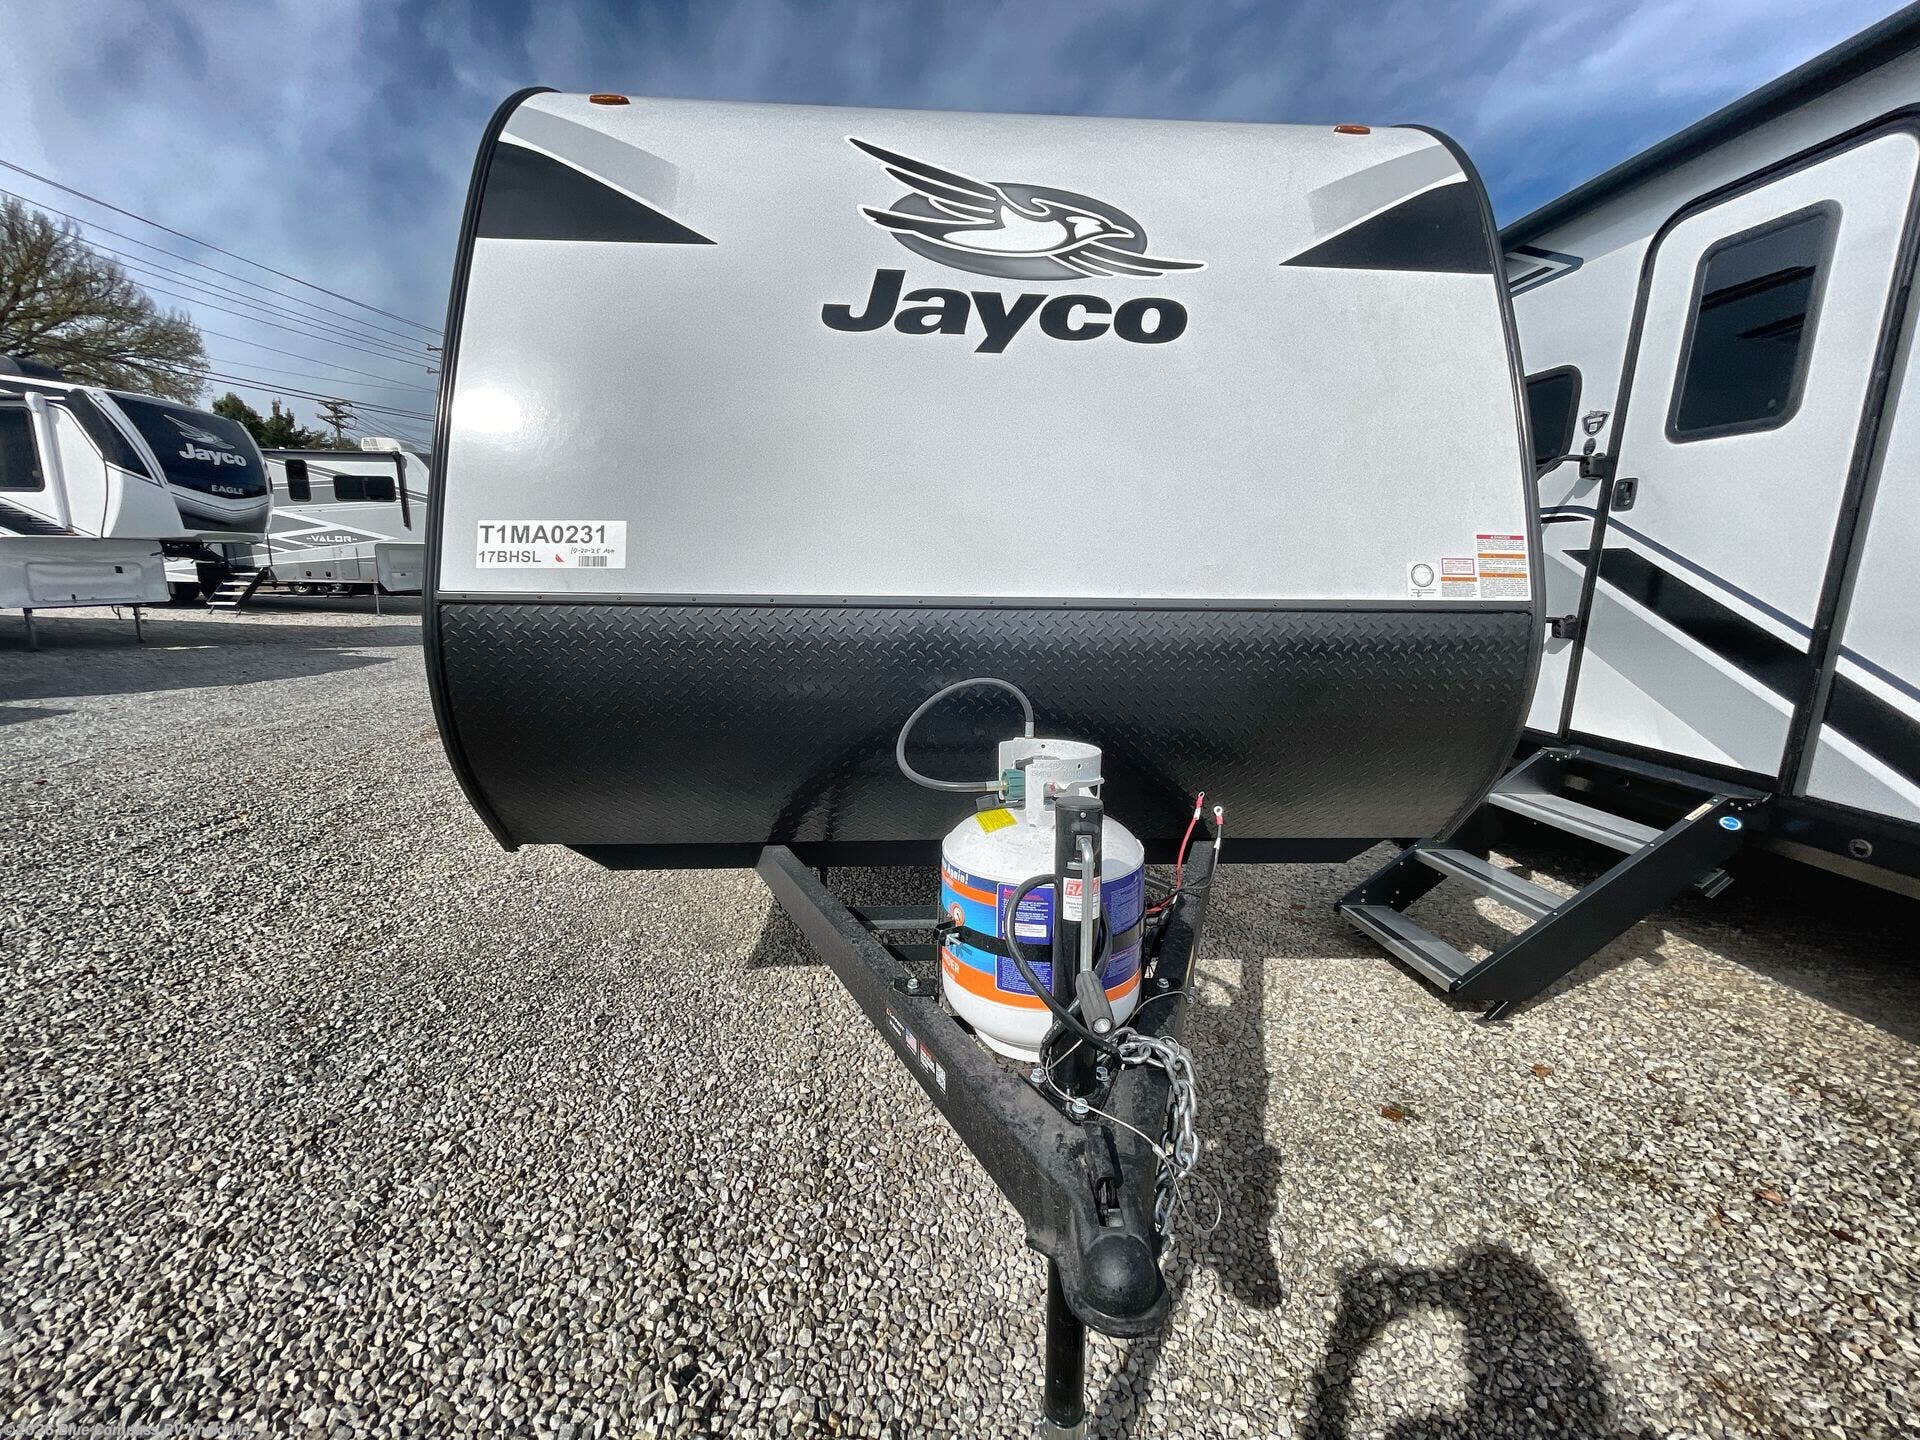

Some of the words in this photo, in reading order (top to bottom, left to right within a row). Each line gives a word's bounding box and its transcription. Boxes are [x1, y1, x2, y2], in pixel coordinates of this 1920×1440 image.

[821, 268, 1188, 354] Jayco
[179, 443, 247, 467] Jayco
[211, 484, 245, 496] EAGLE
[479, 525, 606, 544] T1MA0231
[478, 551, 542, 563] 17BHSL
